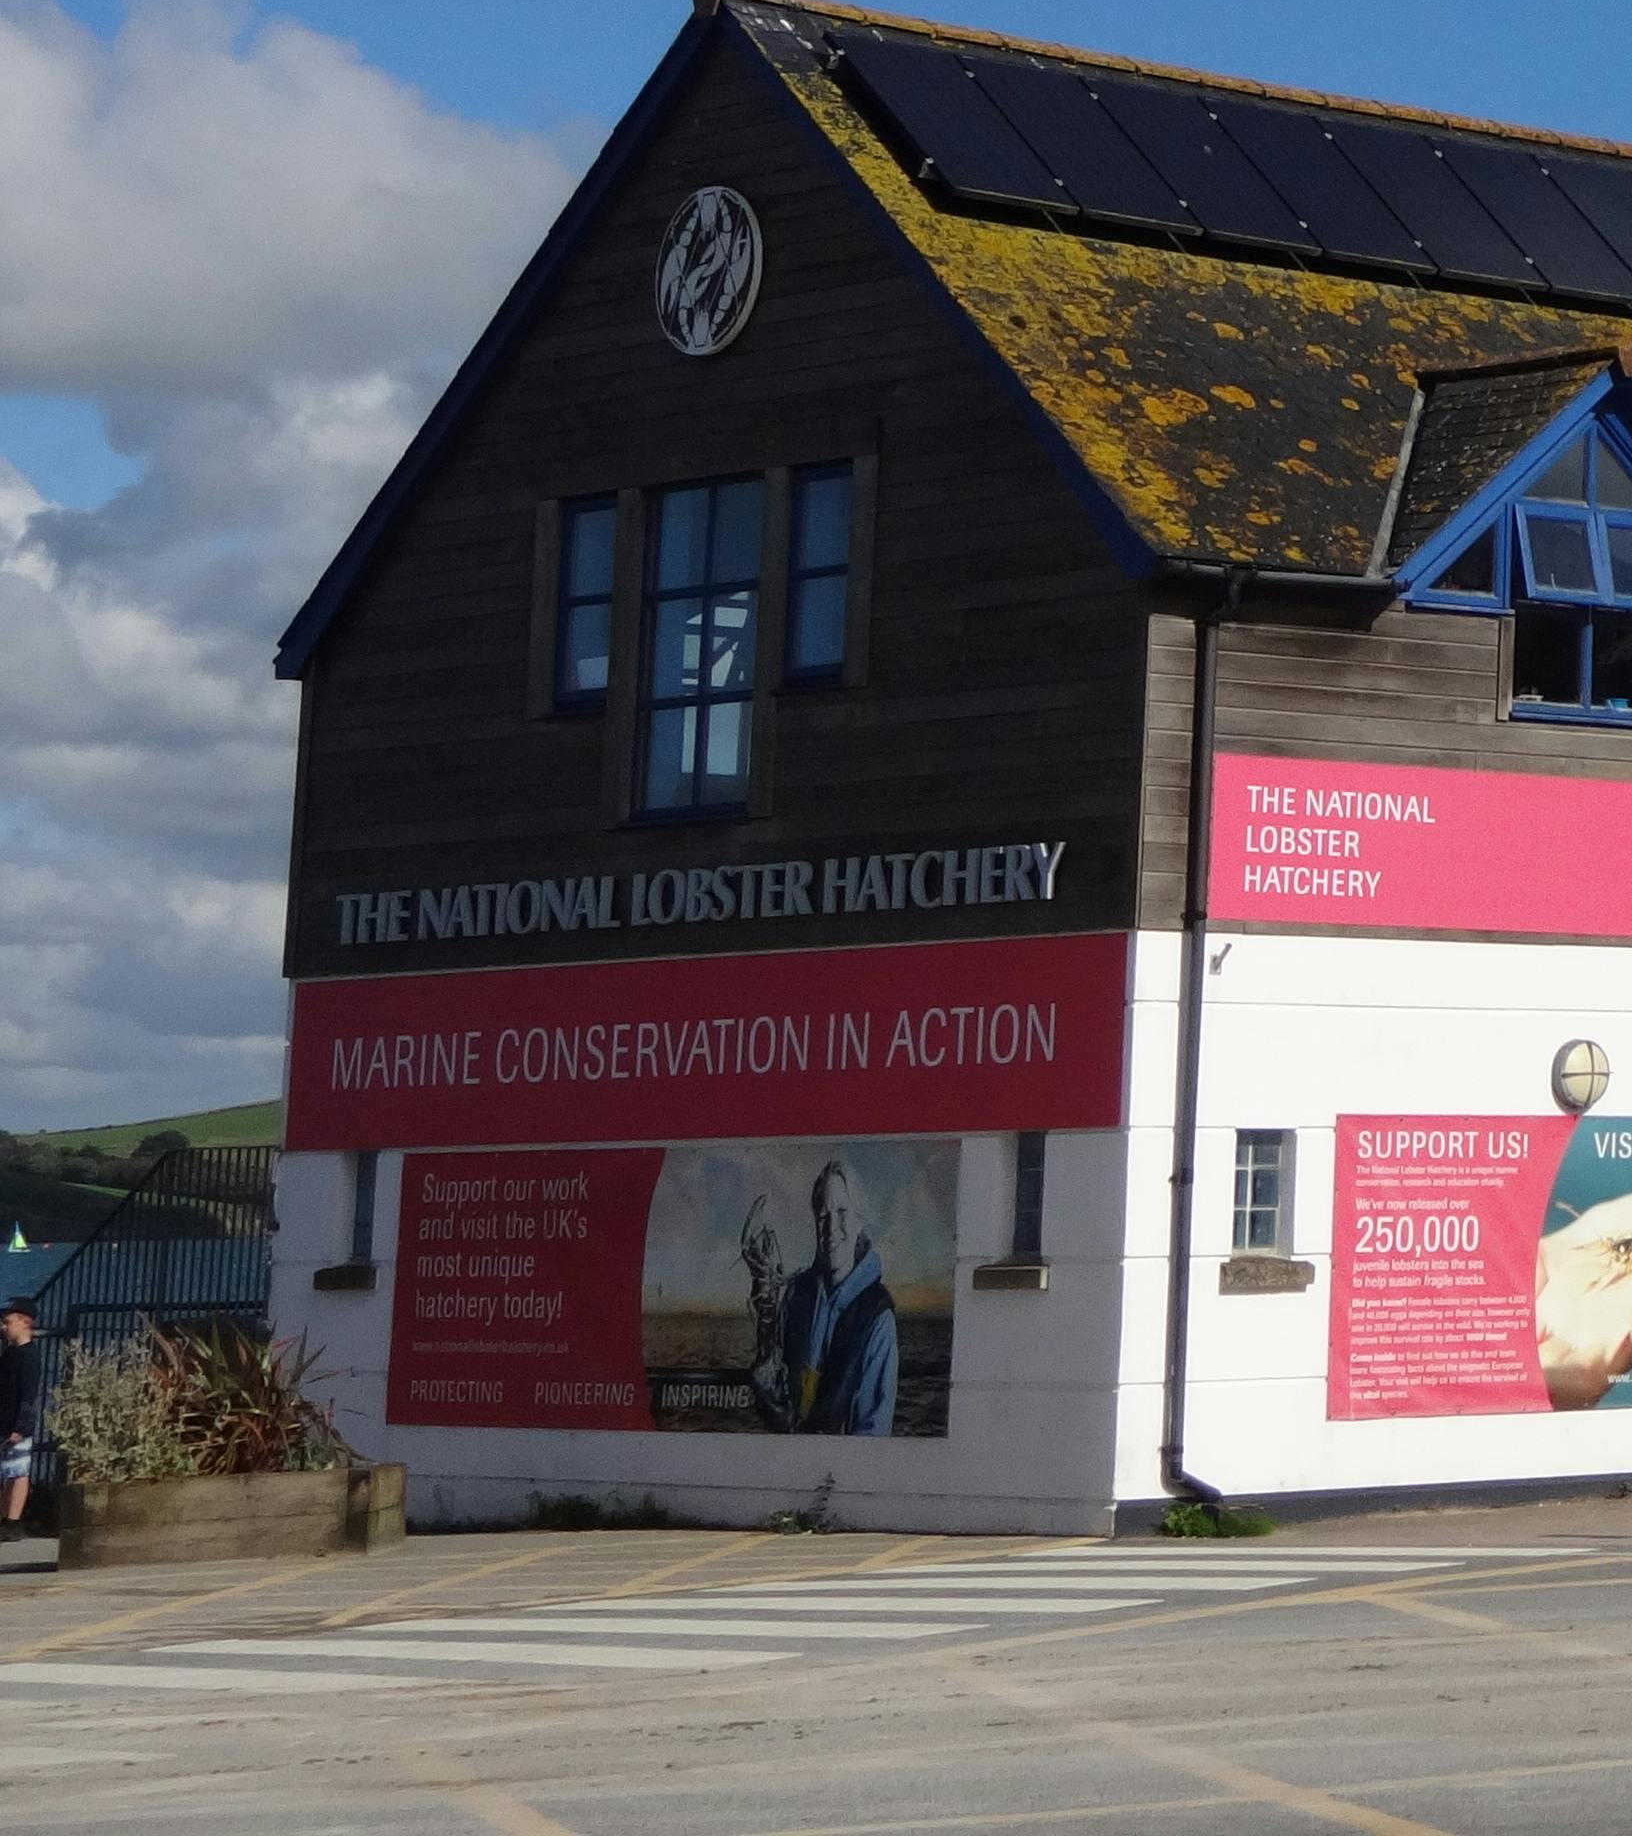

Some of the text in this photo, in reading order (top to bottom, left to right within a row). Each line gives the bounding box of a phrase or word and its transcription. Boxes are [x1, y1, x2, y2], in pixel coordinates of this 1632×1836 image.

[1247, 785, 1436, 823] THE NATIONAL
[1246, 825, 1359, 858] LOBSTER
[336, 841, 1067, 945] THE NATIONAL LOBSTER HATCHERY
[1244, 865, 1381, 898] HATCHERY
[331, 1003, 1056, 1090] MARINE CONSERVATION IN ACTION
[1358, 1130, 1528, 1159] SUPPORT US!
[423, 1171, 589, 1210] Support our work
[1355, 1198, 1470, 1210] We've now released over
[419, 1210, 588, 1240] and visit the UK's
[1355, 1216, 1479, 1257] 250,000
[417, 1249, 535, 1284] most unique
[1353, 1259, 1484, 1274] juvenile lobsters into the sea
[1353, 1274, 1486, 1289] to help sustain fragile stocks.
[415, 1290, 563, 1326] hatchery today!
[410, 1379, 750, 1408] PROTECTING PIONEERING INSPIRING
